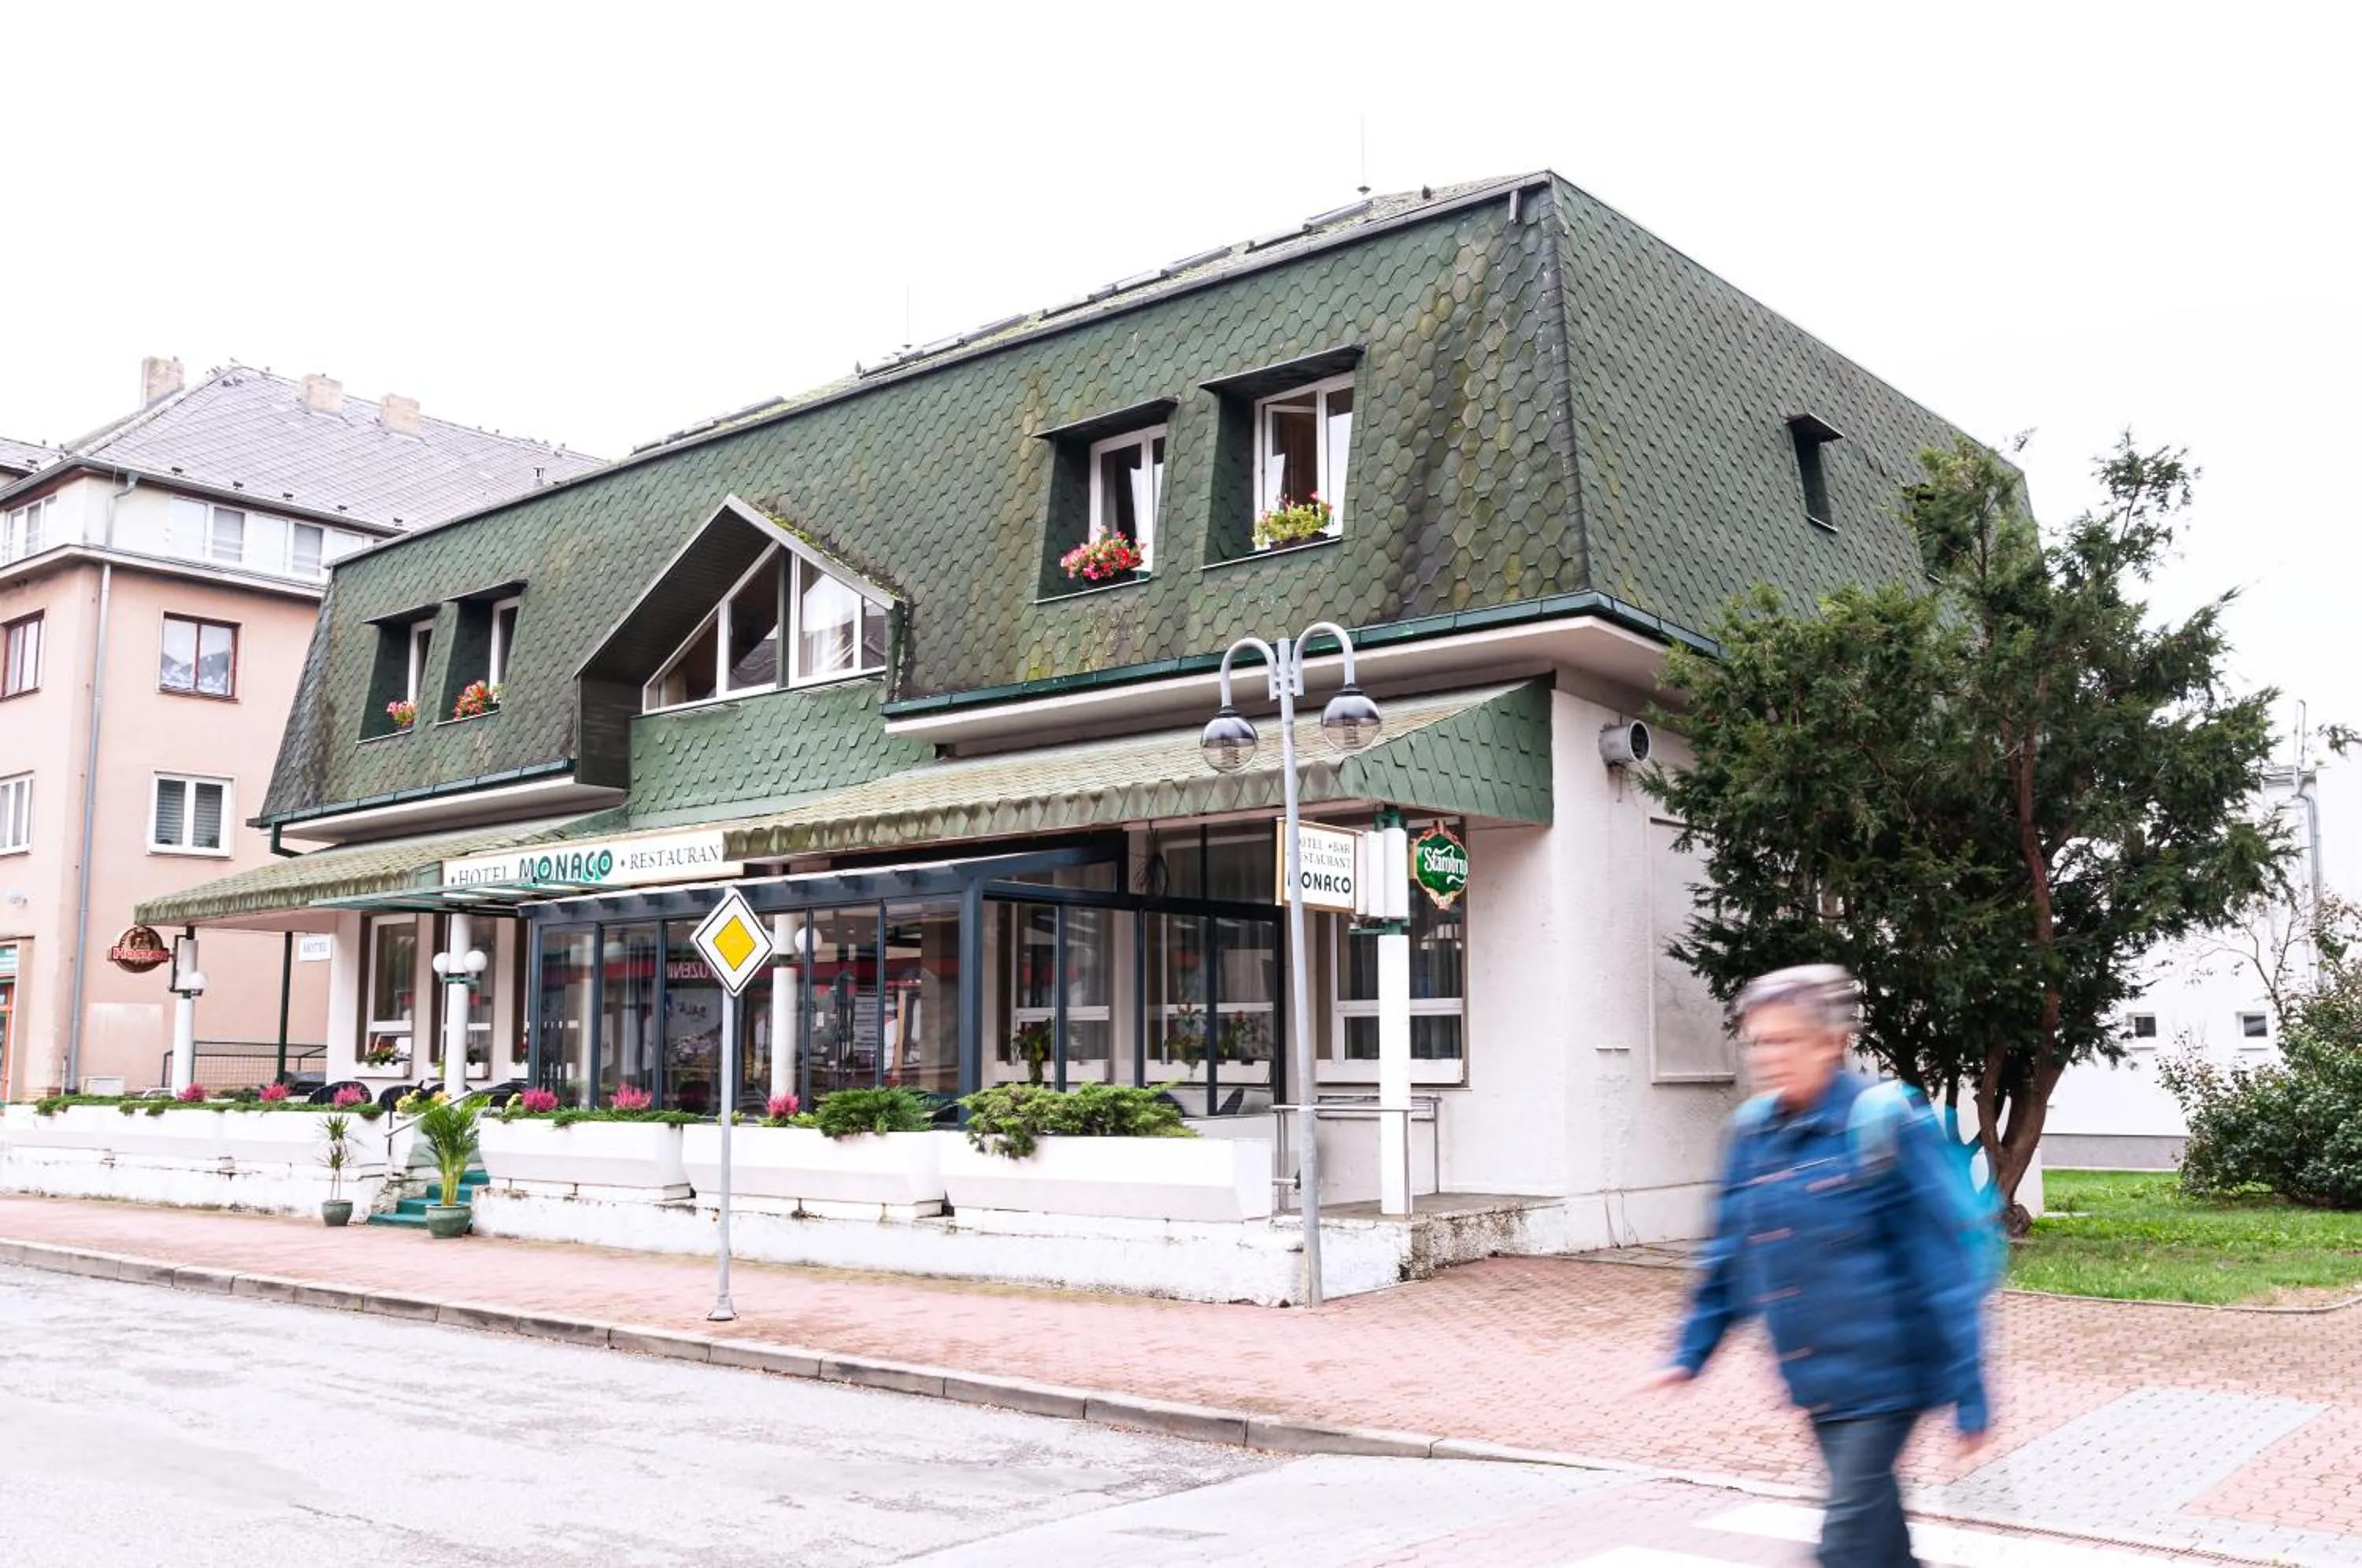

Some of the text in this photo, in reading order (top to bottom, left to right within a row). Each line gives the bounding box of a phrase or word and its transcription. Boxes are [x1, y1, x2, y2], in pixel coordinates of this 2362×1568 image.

[1298, 837, 1350, 854] OTEL BAR
[459, 845, 723, 886] HOTEL MONACO RESTAURAN
[1287, 852, 1351, 869] ESTAURANT
[1287, 871, 1352, 894] ONACO
